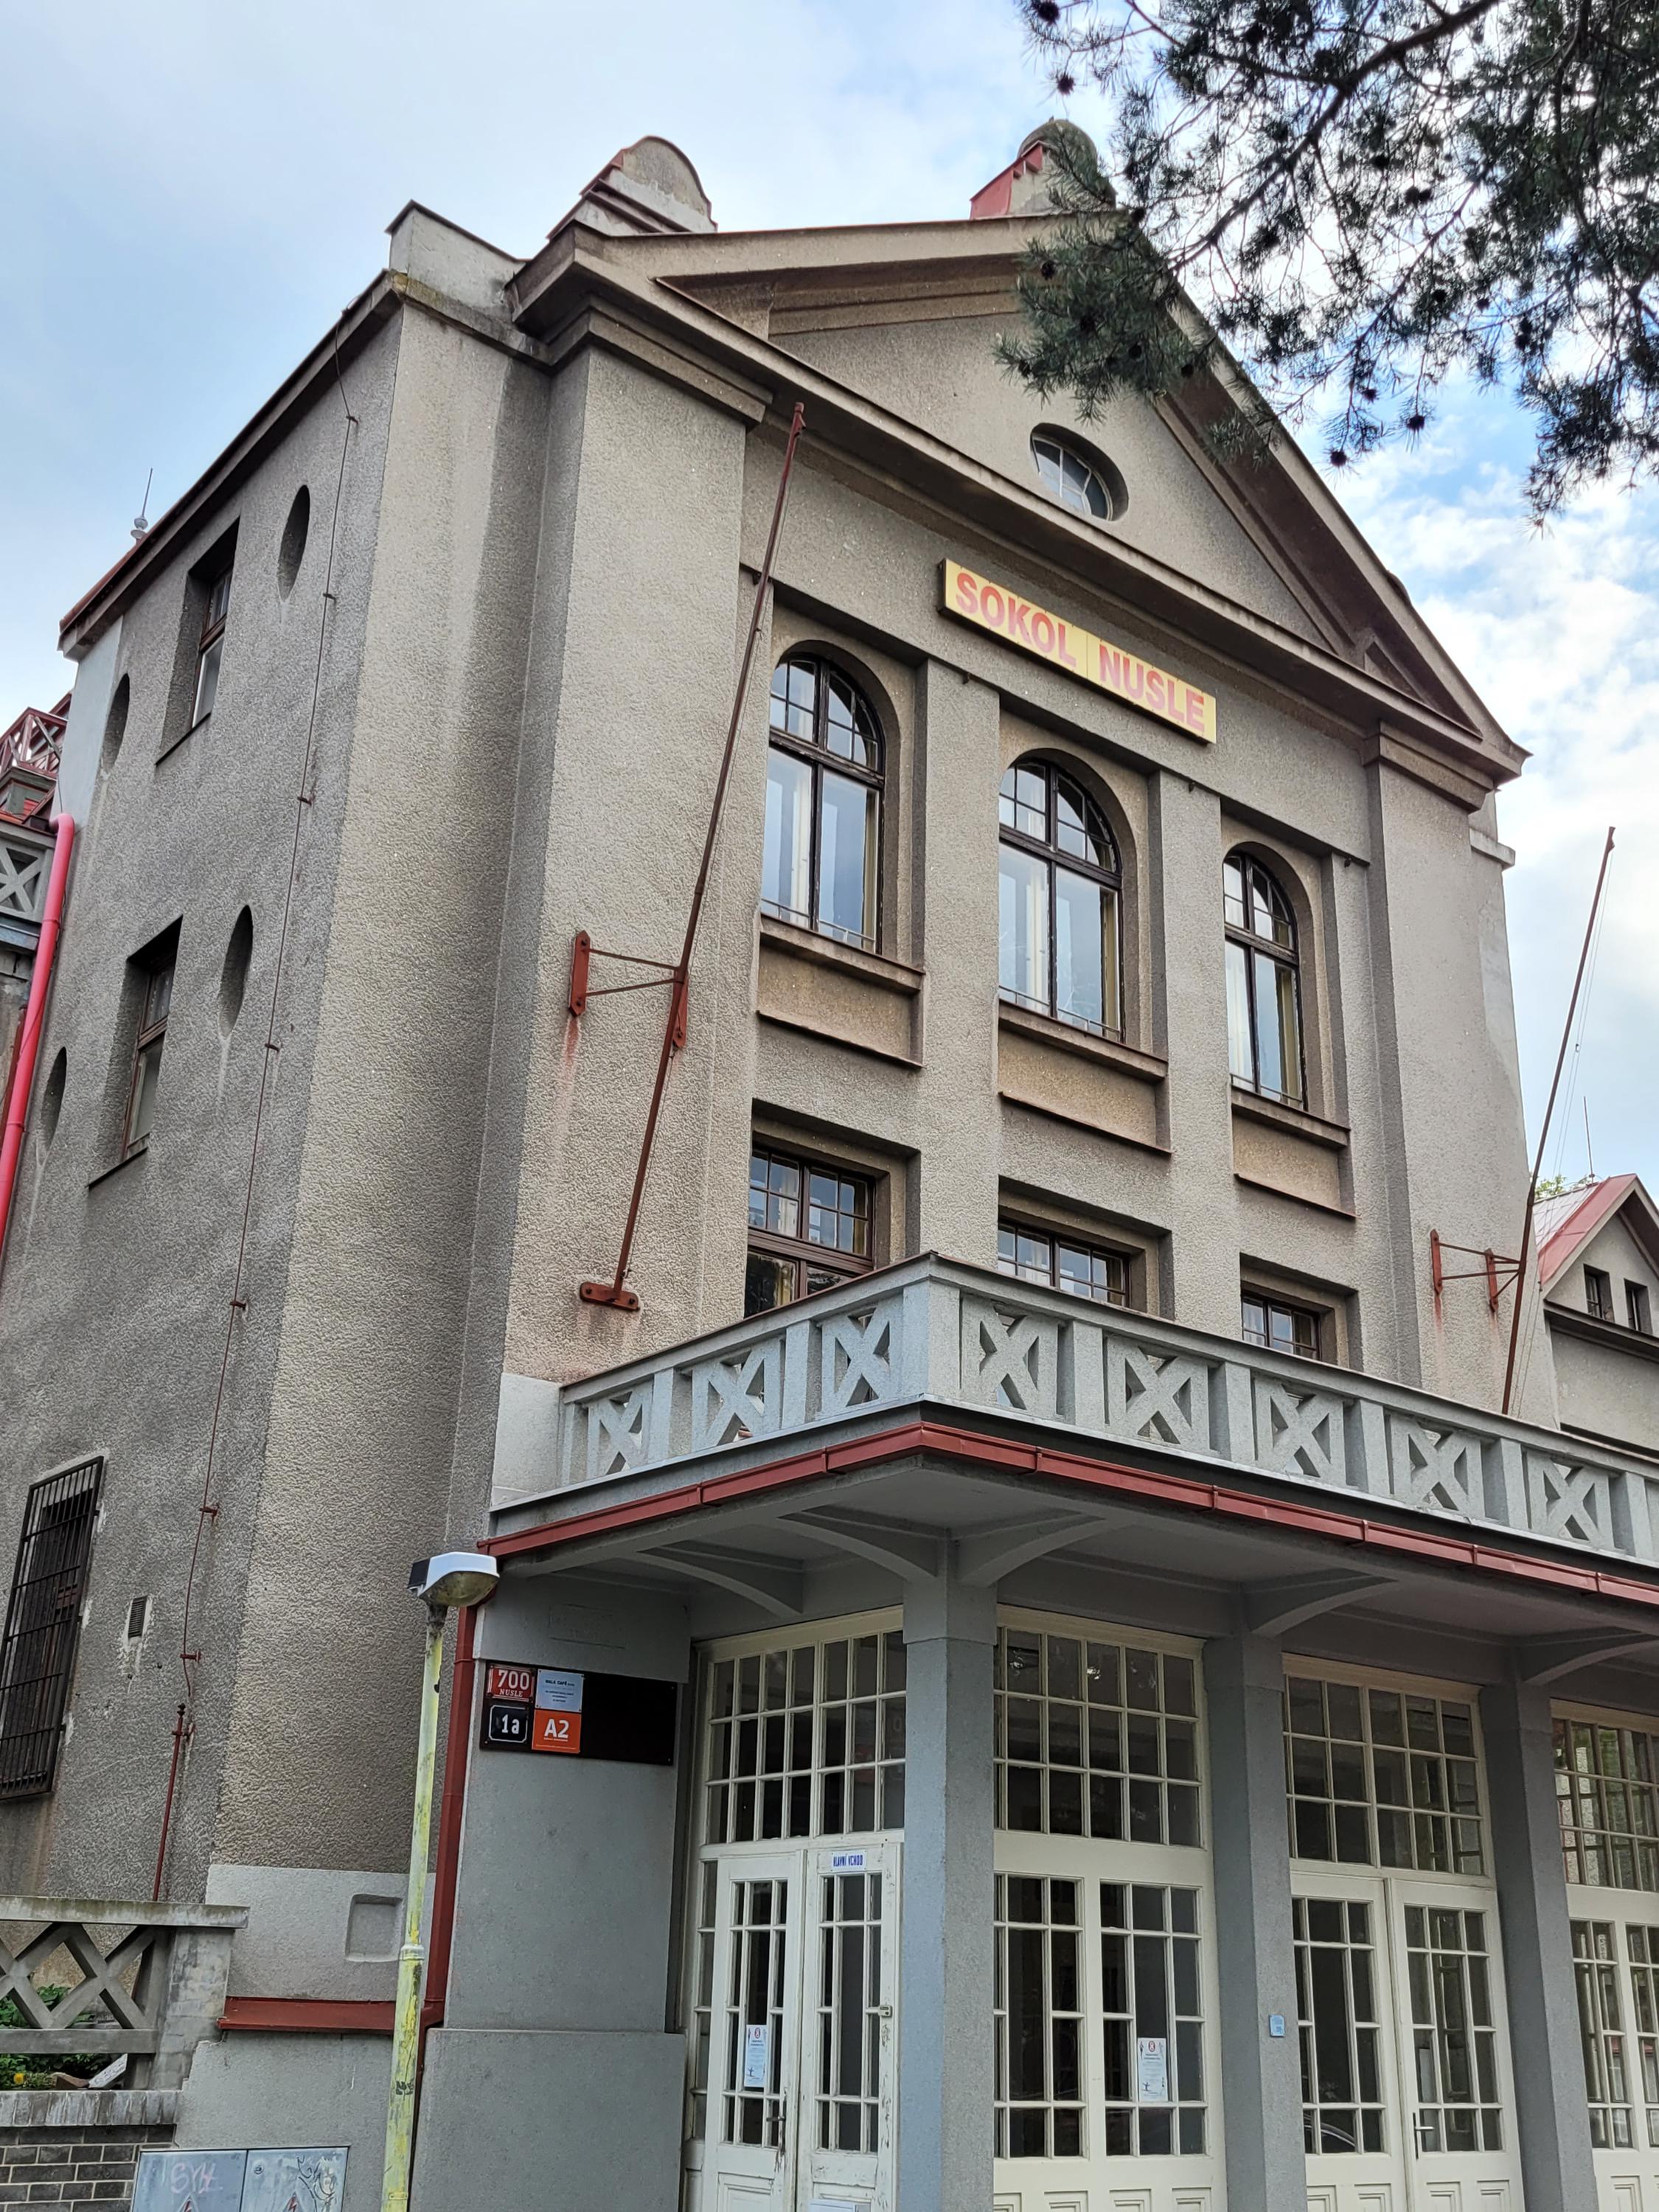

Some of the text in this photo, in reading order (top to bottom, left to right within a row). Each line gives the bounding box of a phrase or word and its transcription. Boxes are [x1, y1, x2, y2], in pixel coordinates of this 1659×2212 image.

[956, 572, 1205, 733] SOKOL NUSLE
[498, 1669, 529, 1690] 700
[499, 1688, 524, 1697] NUSLE
[501, 1714, 520, 1734] 1a
[544, 1718, 569, 1739] A2
